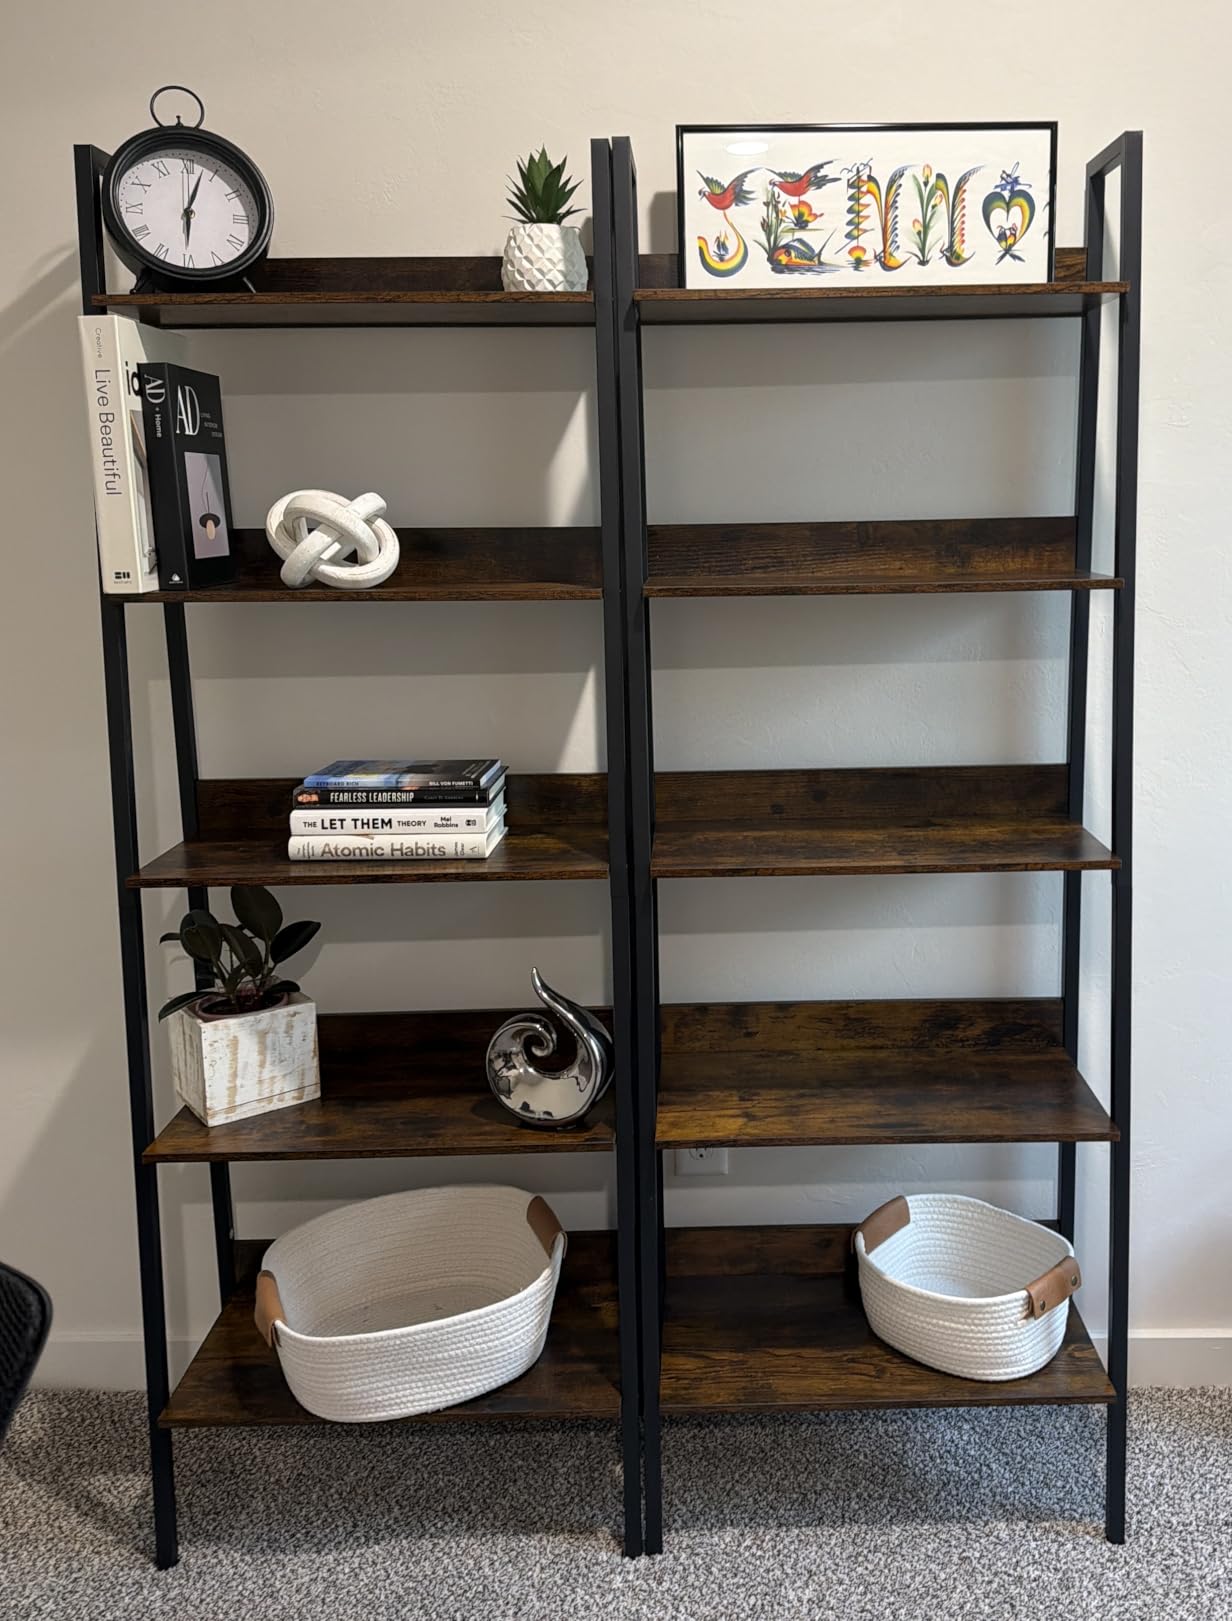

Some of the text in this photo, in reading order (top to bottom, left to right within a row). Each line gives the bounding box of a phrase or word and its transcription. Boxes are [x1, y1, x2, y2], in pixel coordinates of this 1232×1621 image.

[151, 161, 170, 178] XI
[131, 176, 151, 194] X
[143, 374, 166, 438] AD Home
[175, 384, 200, 436] AD
[95, 369, 123, 496] Live Beautiful
[329, 791, 367, 803] FEARLESS
[368, 791, 415, 803] LEADERSHIP
[321, 818, 346, 830] LET
[351, 817, 393, 830] THEM
[396, 820, 427, 828] THEORY
[320, 842, 385, 858] Atomic
[390, 841, 447, 857] Habits
